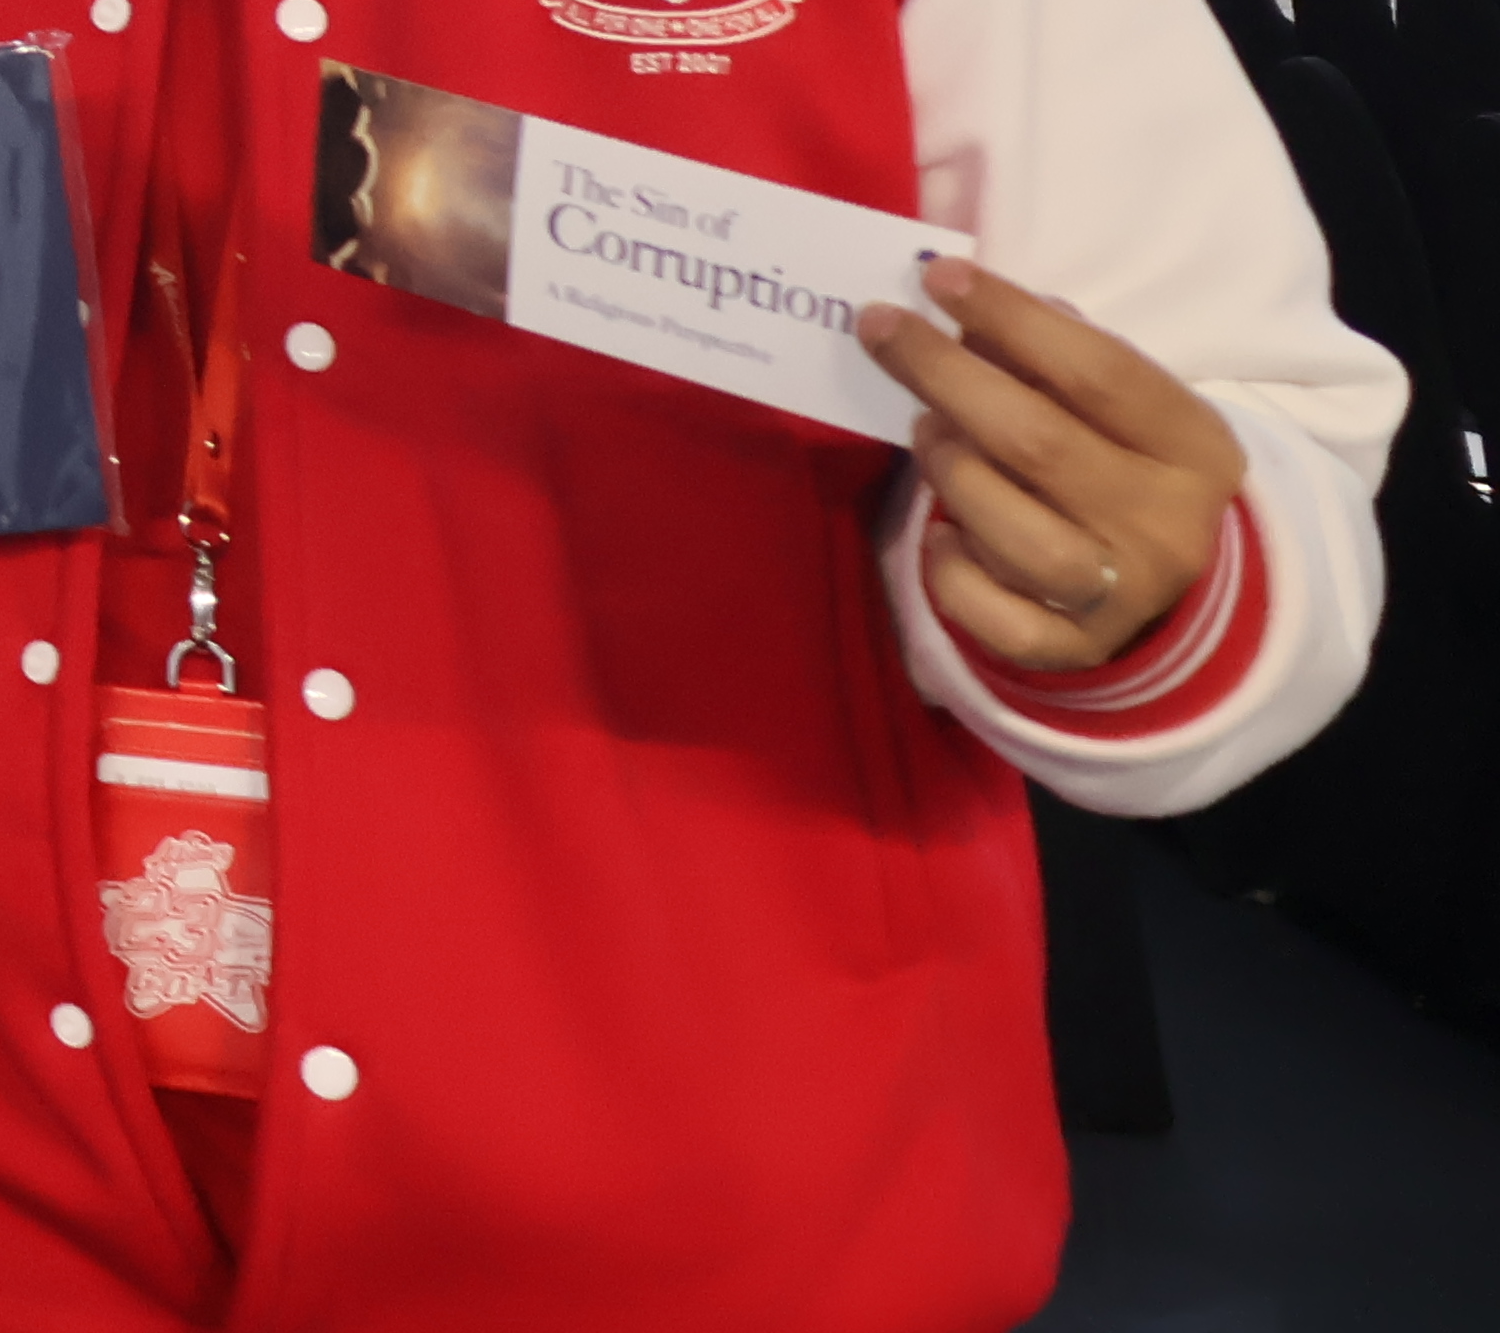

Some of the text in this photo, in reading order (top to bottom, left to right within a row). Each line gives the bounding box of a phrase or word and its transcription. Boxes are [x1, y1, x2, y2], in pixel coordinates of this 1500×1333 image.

[553, 159, 739, 241] The Sin of
[547, 201, 856, 335] Corruption
